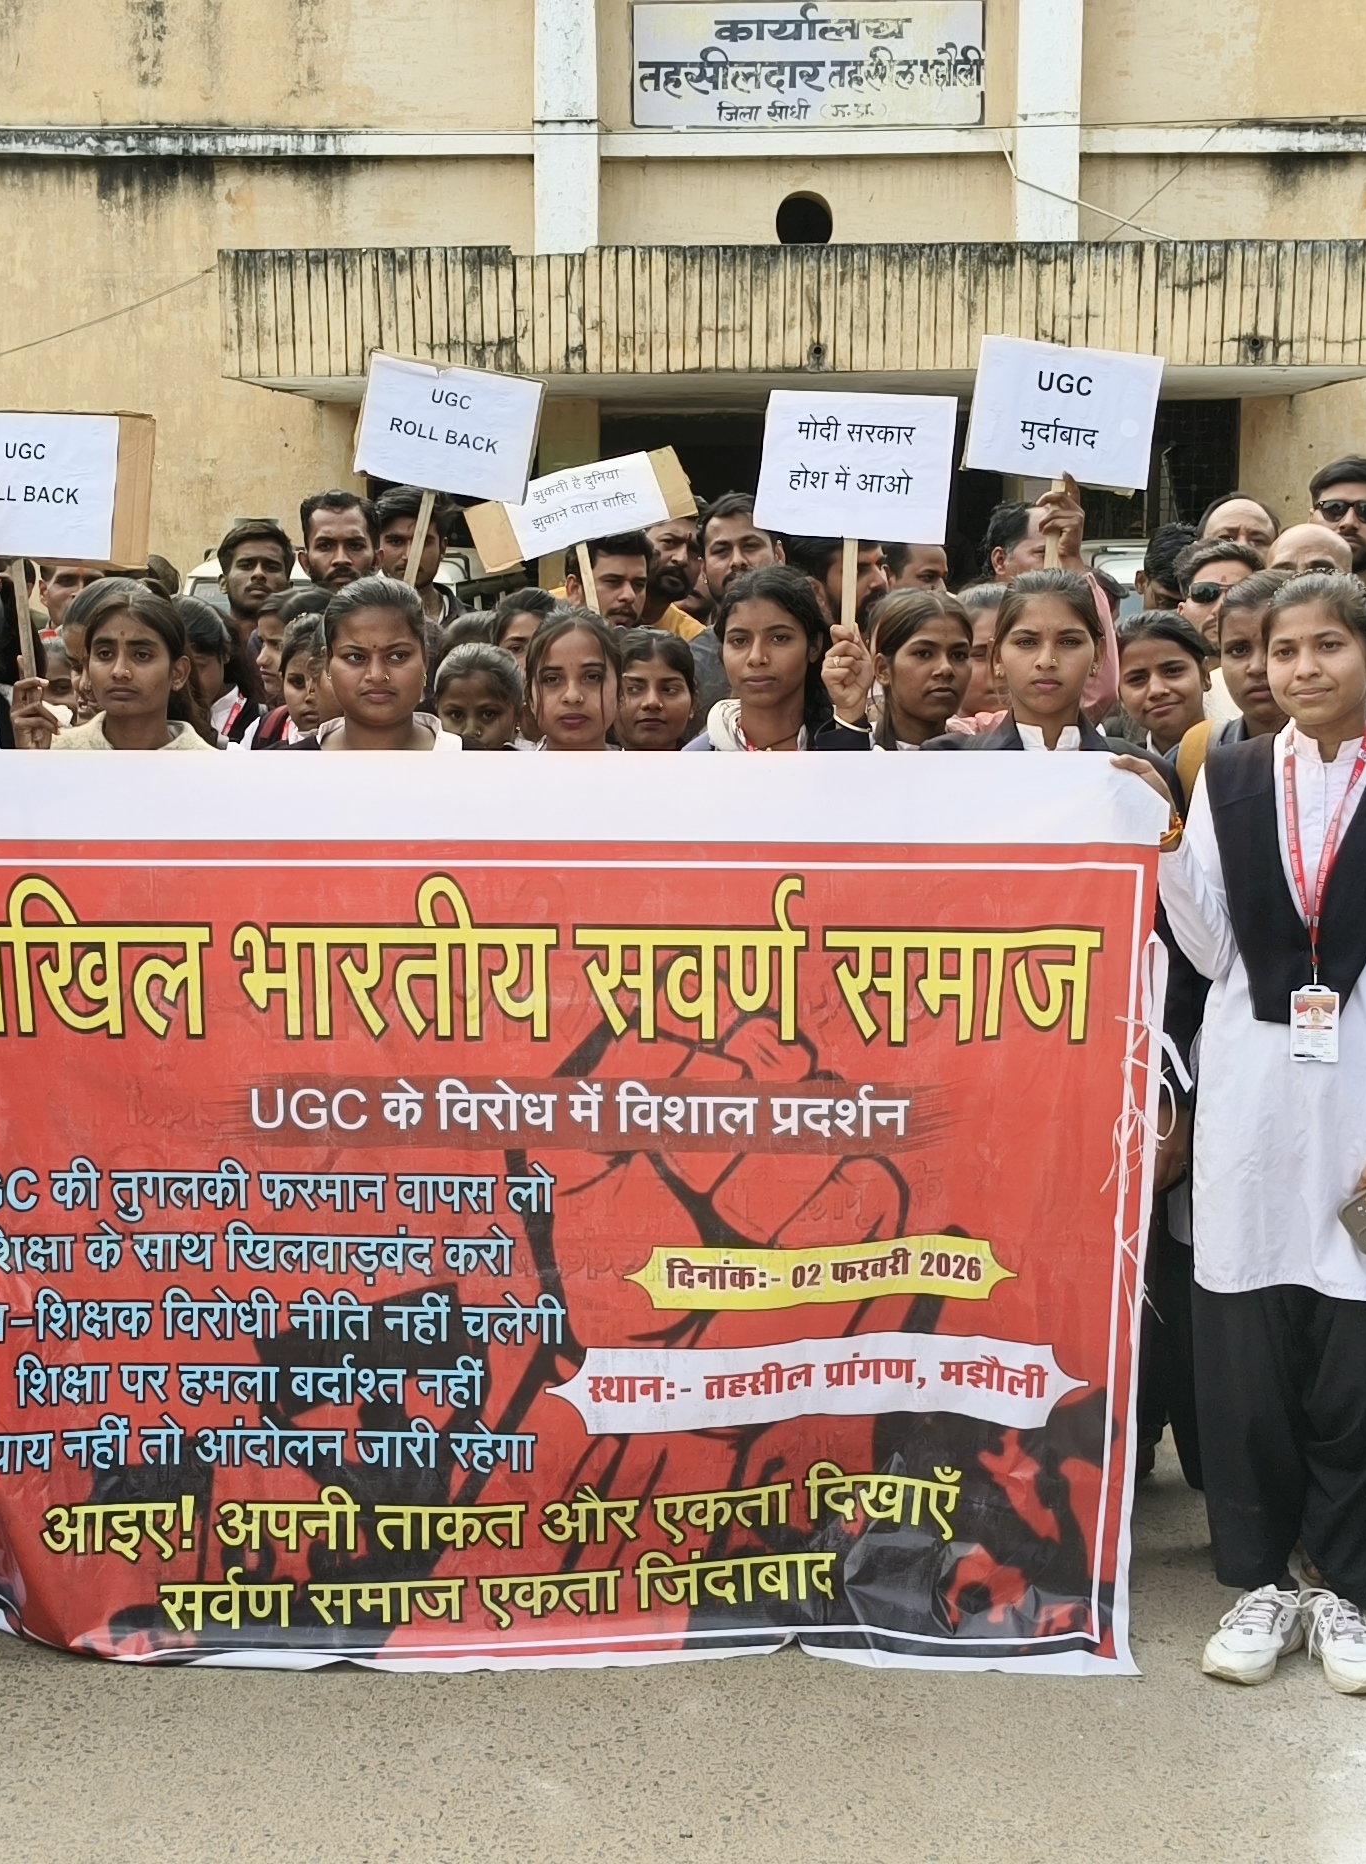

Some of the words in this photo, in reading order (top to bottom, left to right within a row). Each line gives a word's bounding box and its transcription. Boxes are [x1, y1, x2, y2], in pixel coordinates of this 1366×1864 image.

[715, 3, 912, 42] कार्यालय
[638, 46, 825, 98] तहसीलदार
[828, 46, 918, 93] तहसील
[717, 101, 762, 122] जिला
[767, 98, 811, 122] सीधी
[431, 388, 472, 411] UGC
[1038, 371, 1093, 396] UGC
[389, 417, 439, 442] ROLL
[445, 429, 499, 455] BACK
[797, 414, 841, 442] मोदी
[847, 422, 916, 446] सरकार
[1020, 418, 1099, 451] मुर्दाबाद
[5, 442, 46, 461] UGC
[24, 485, 79, 504] BACK
[532, 479, 569, 504] झुकती
[571, 476, 581, 489] है
[584, 469, 619, 490] दुनिया
[789, 462, 828, 491] होश
[834, 465, 852, 491] में
[856, 469, 913, 496] आओ
[532, 506, 568, 532] झुकाने
[571, 500, 598, 514] वाला
[601, 492, 637, 507] चाहिए
[231, 871, 559, 1042] भारतीय
[572, 871, 807, 1045] सवर्ण
[824, 926, 1105, 1047] समाज
[250, 1087, 368, 1133] UGC
[382, 1078, 425, 1131] के
[438, 1078, 557, 1134] विरोध
[570, 1080, 602, 1133] में
[616, 1081, 758, 1138] विशाल
[770, 1083, 911, 1140] प्रदर्शन
[50, 1157, 99, 1213] की
[111, 1158, 249, 1223] तुगलकी
[259, 1168, 385, 1212] फरमान
[396, 1173, 496, 1214] वापस
[506, 1163, 555, 1216] लो
[85, 1223, 124, 1273] के
[133, 1231, 213, 1273] साथ
[226, 1221, 434, 1285] खिलवाड़बंद
[444, 1226, 514, 1278] करो
[791, 1264, 821, 1289] 02
[831, 1246, 911, 1285] फरवरी
[919, 1251, 983, 1283] 2026
[162, 1288, 279, 1342] विरोधी
[289, 1288, 373, 1343] नीति
[383, 1292, 451, 1344] नहीं
[462, 1294, 567, 1347] चलेगी
[15, 1352, 108, 1409] शिक्षा
[120, 1362, 168, 1404] पर
[178, 1365, 280, 1404] हमला
[290, 1352, 405, 1407] बर्दाश्त
[417, 1354, 485, 1410] नहीं
[702, 1356, 812, 1401] तहसील
[825, 1350, 926, 1391] प्रांगण,
[940, 1353, 1048, 1400] मझौली
[62, 1415, 131, 1470] नहीं
[140, 1413, 184, 1467] तो
[195, 1414, 346, 1468] आंदोलन
[356, 1415, 437, 1468] जारी
[450, 1426, 537, 1474] रहेगा
[42, 1494, 195, 1561] आइए!
[216, 1486, 361, 1552] अपनी
[375, 1502, 525, 1550] ताकत
[542, 1484, 639, 1545] और
[653, 1482, 792, 1545] एकता
[806, 1461, 964, 1541] दिखाएँ
[160, 1566, 295, 1632] सर्वण
[309, 1577, 466, 1628] समाज
[481, 1566, 620, 1629] एकता
[636, 1550, 837, 1611] जिंदाबाद
